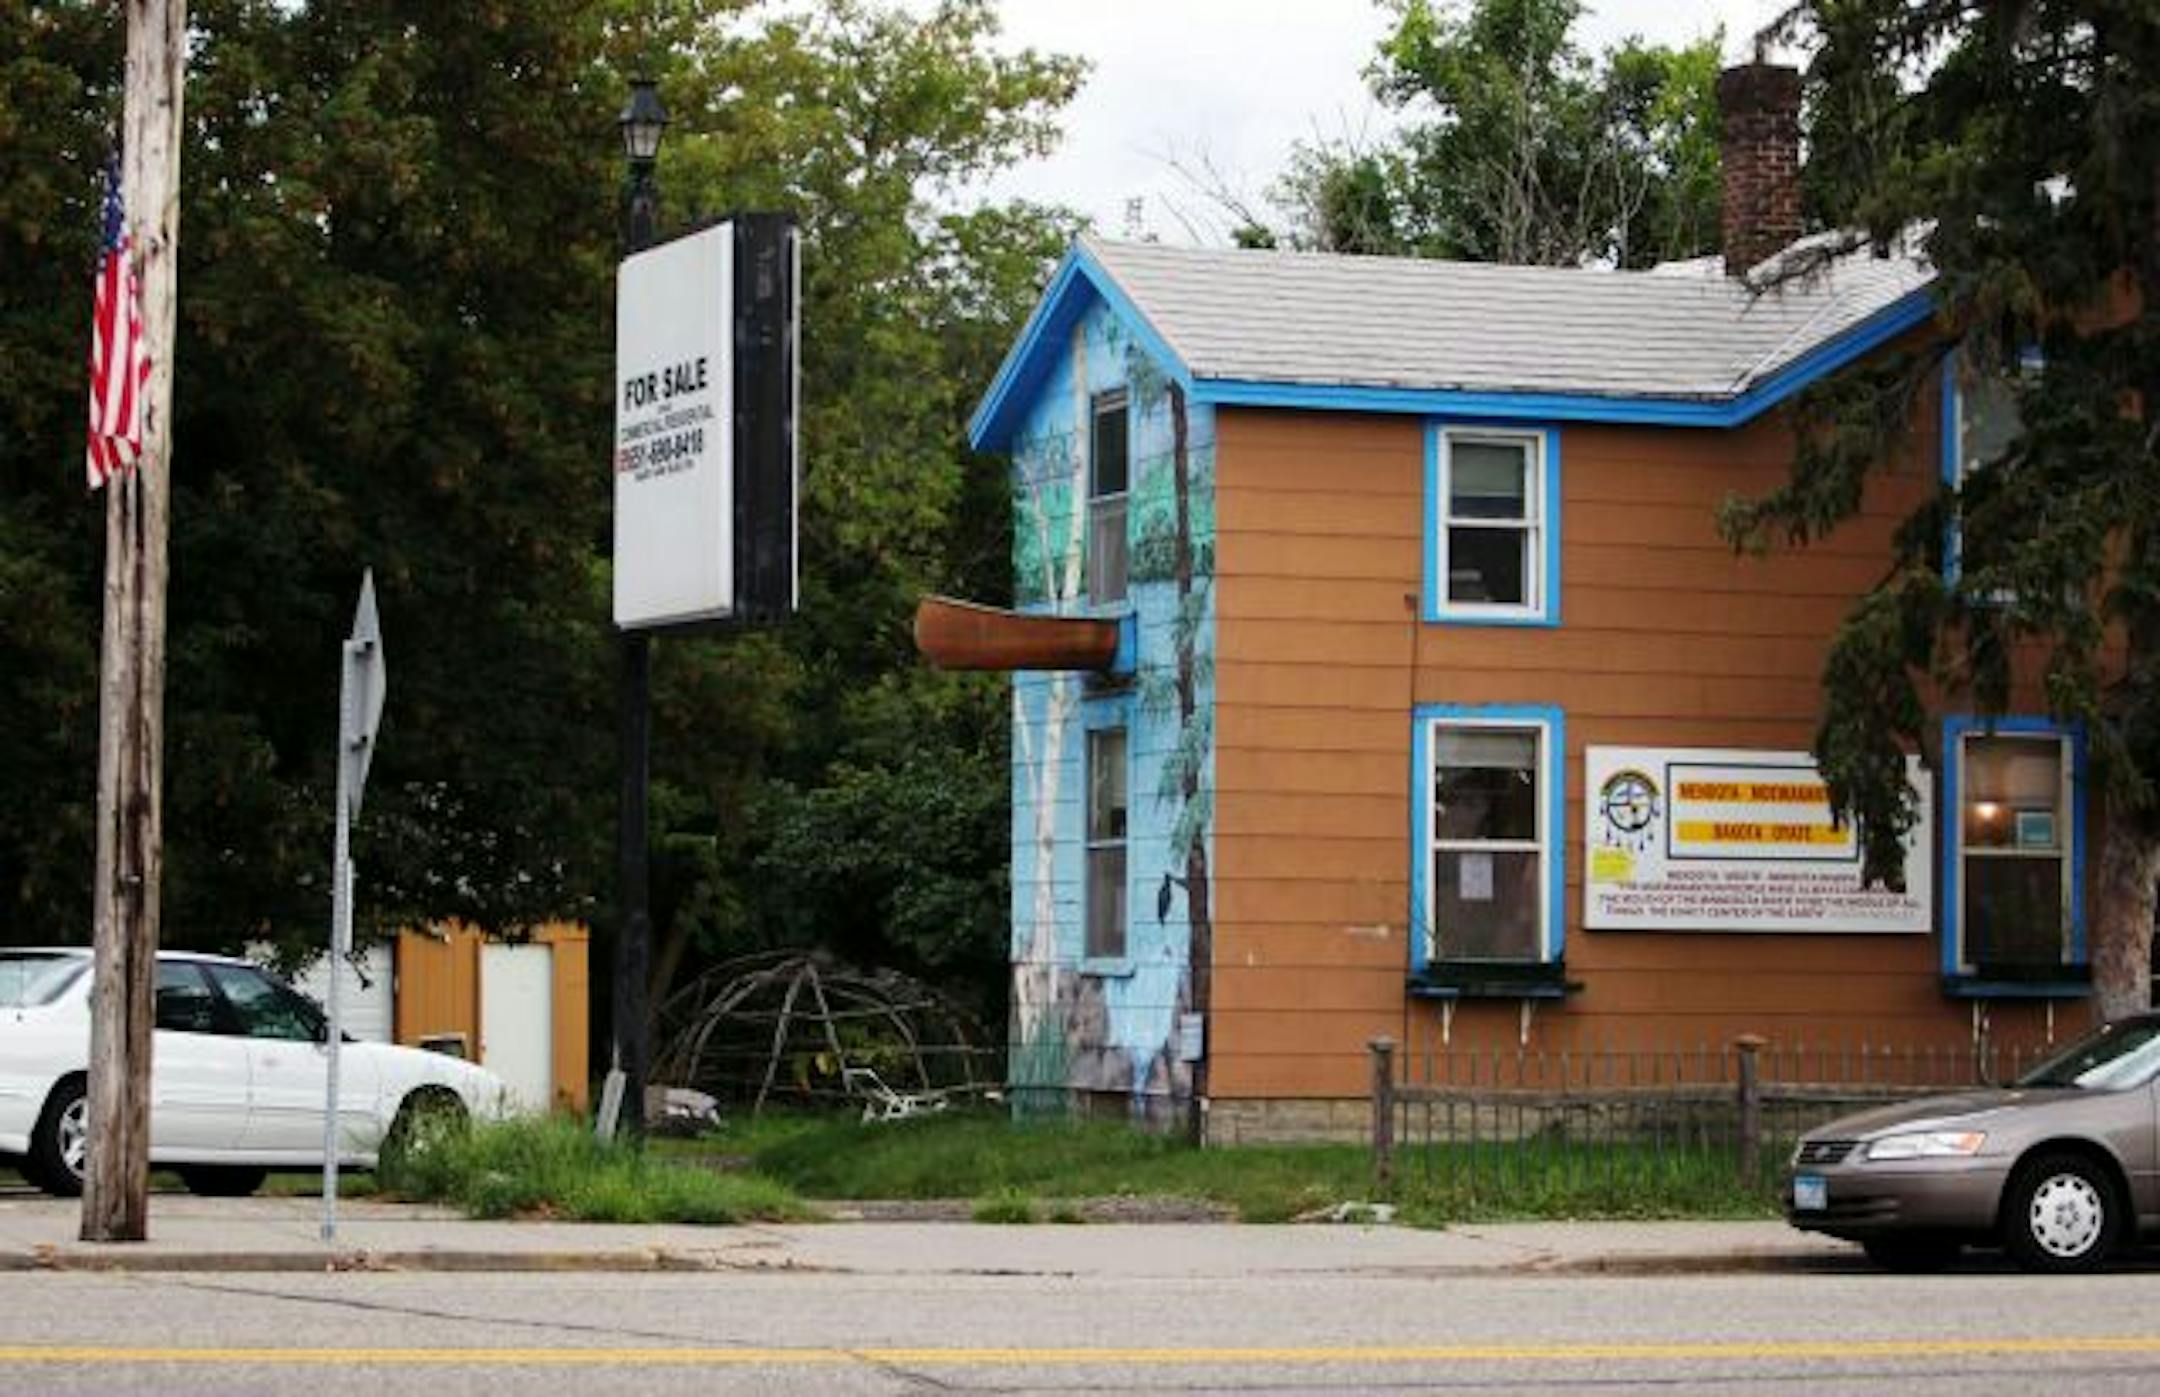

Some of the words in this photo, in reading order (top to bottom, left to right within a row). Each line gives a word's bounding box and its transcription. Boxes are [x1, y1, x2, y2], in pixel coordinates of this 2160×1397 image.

[624, 373, 658, 411] FOR
[662, 357, 707, 398] SALE
[1680, 783, 1738, 800] MENDOTA
